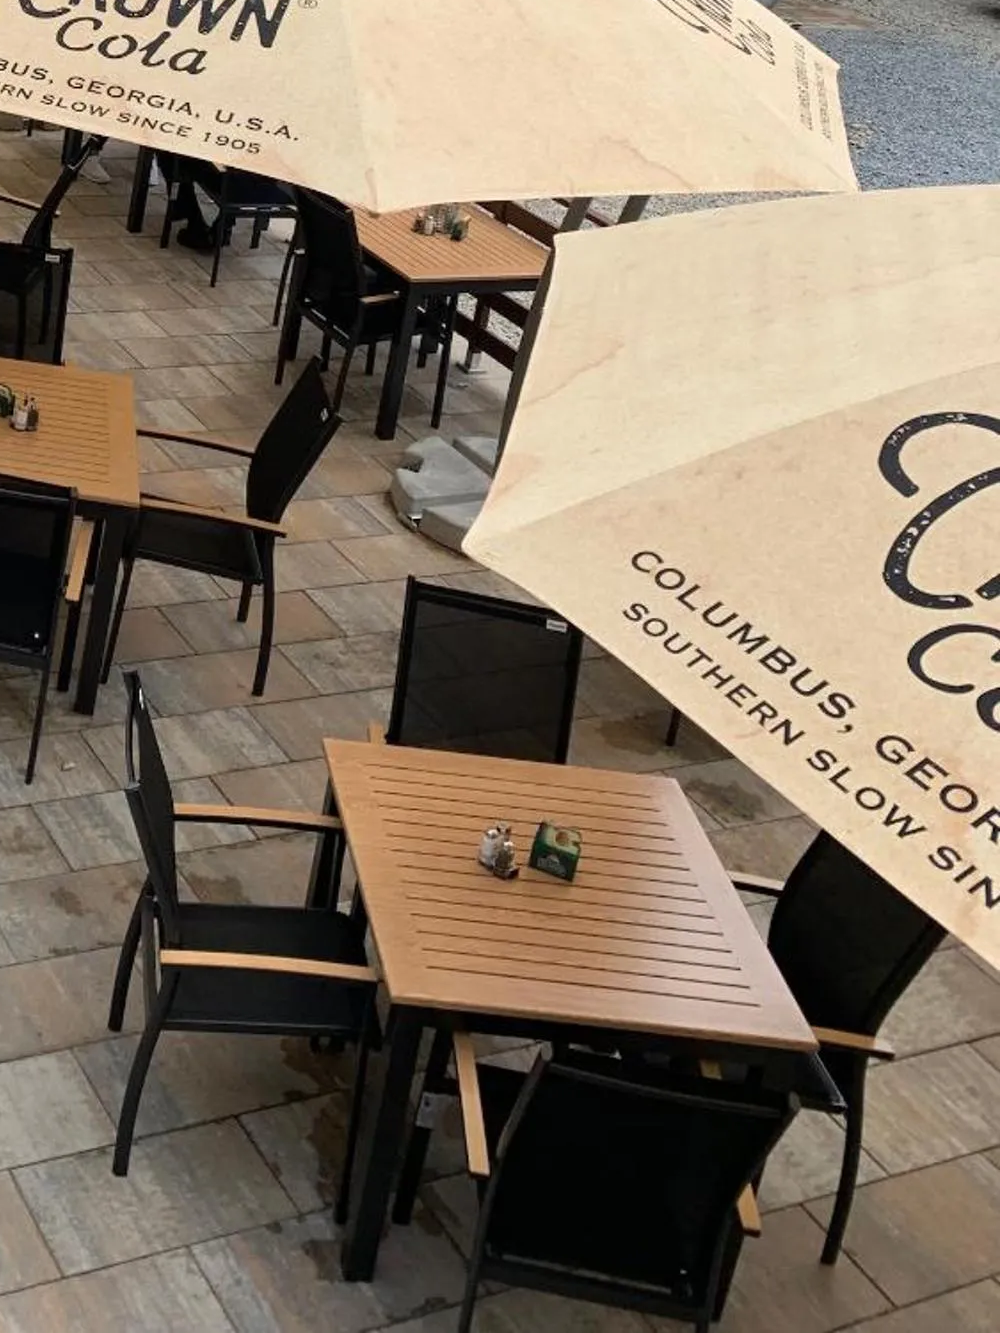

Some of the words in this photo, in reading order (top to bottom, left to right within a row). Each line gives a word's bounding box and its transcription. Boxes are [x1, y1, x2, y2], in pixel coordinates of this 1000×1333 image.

[56, 16, 208, 75] Cola
[40, 94, 110, 118] SLOW
[118, 112, 190, 139] SINCE
[202, 132, 261, 156] 1905
[215, 109, 299, 141] U.S.A.
[631, 550, 855, 733] COLUMBUS,
[621, 602, 806, 747] SOUTHERN
[806, 749, 928, 839] SLOW
